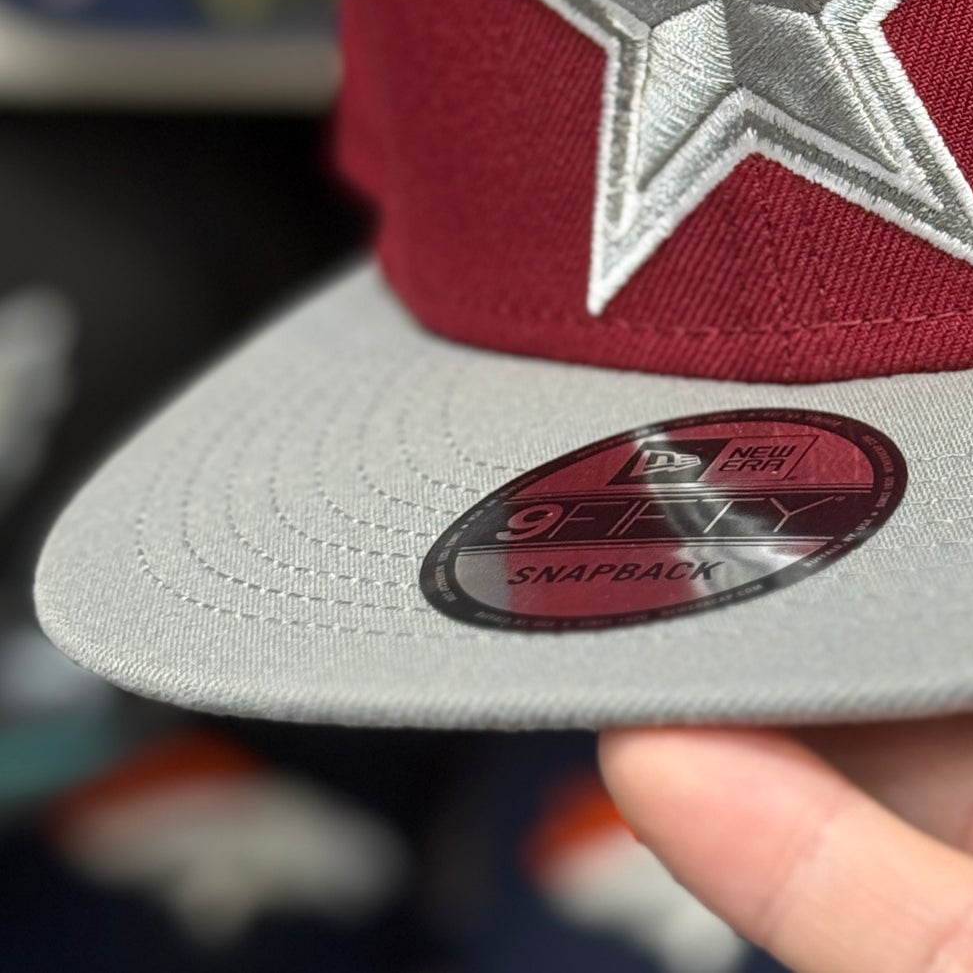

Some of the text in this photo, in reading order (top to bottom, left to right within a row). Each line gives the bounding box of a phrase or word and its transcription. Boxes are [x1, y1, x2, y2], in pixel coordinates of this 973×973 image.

[728, 444, 797, 459] NEW
[718, 458, 786, 472] ERA
[507, 561, 725, 585] SNAPBACK
